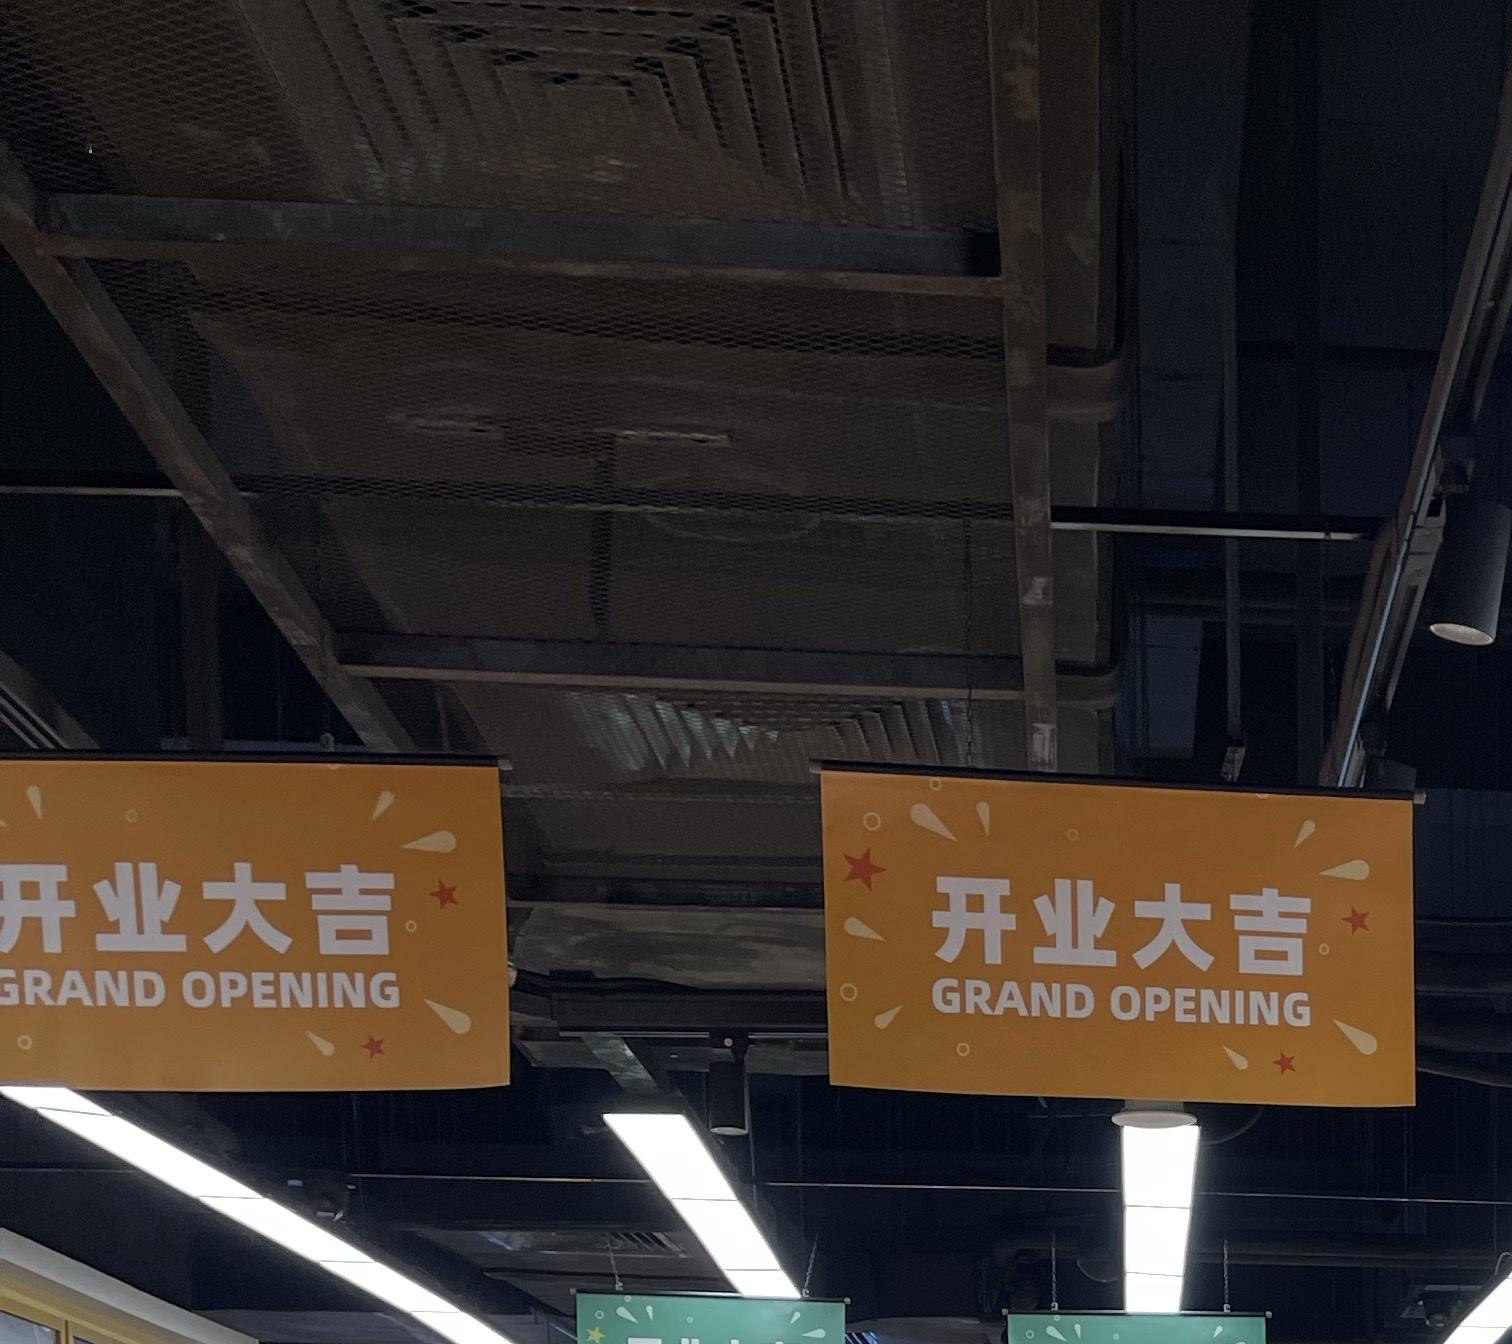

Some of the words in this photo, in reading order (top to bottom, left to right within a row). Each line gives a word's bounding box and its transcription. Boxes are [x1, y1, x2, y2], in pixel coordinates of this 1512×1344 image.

[0, 862, 397, 956] 开业大吉
[931, 875, 1312, 976] 开业大吉
[0, 969, 166, 1008] GRAND
[182, 971, 400, 1009] OPENING
[931, 978, 1096, 1020] GRAND
[1110, 984, 1312, 1028] OPENING
